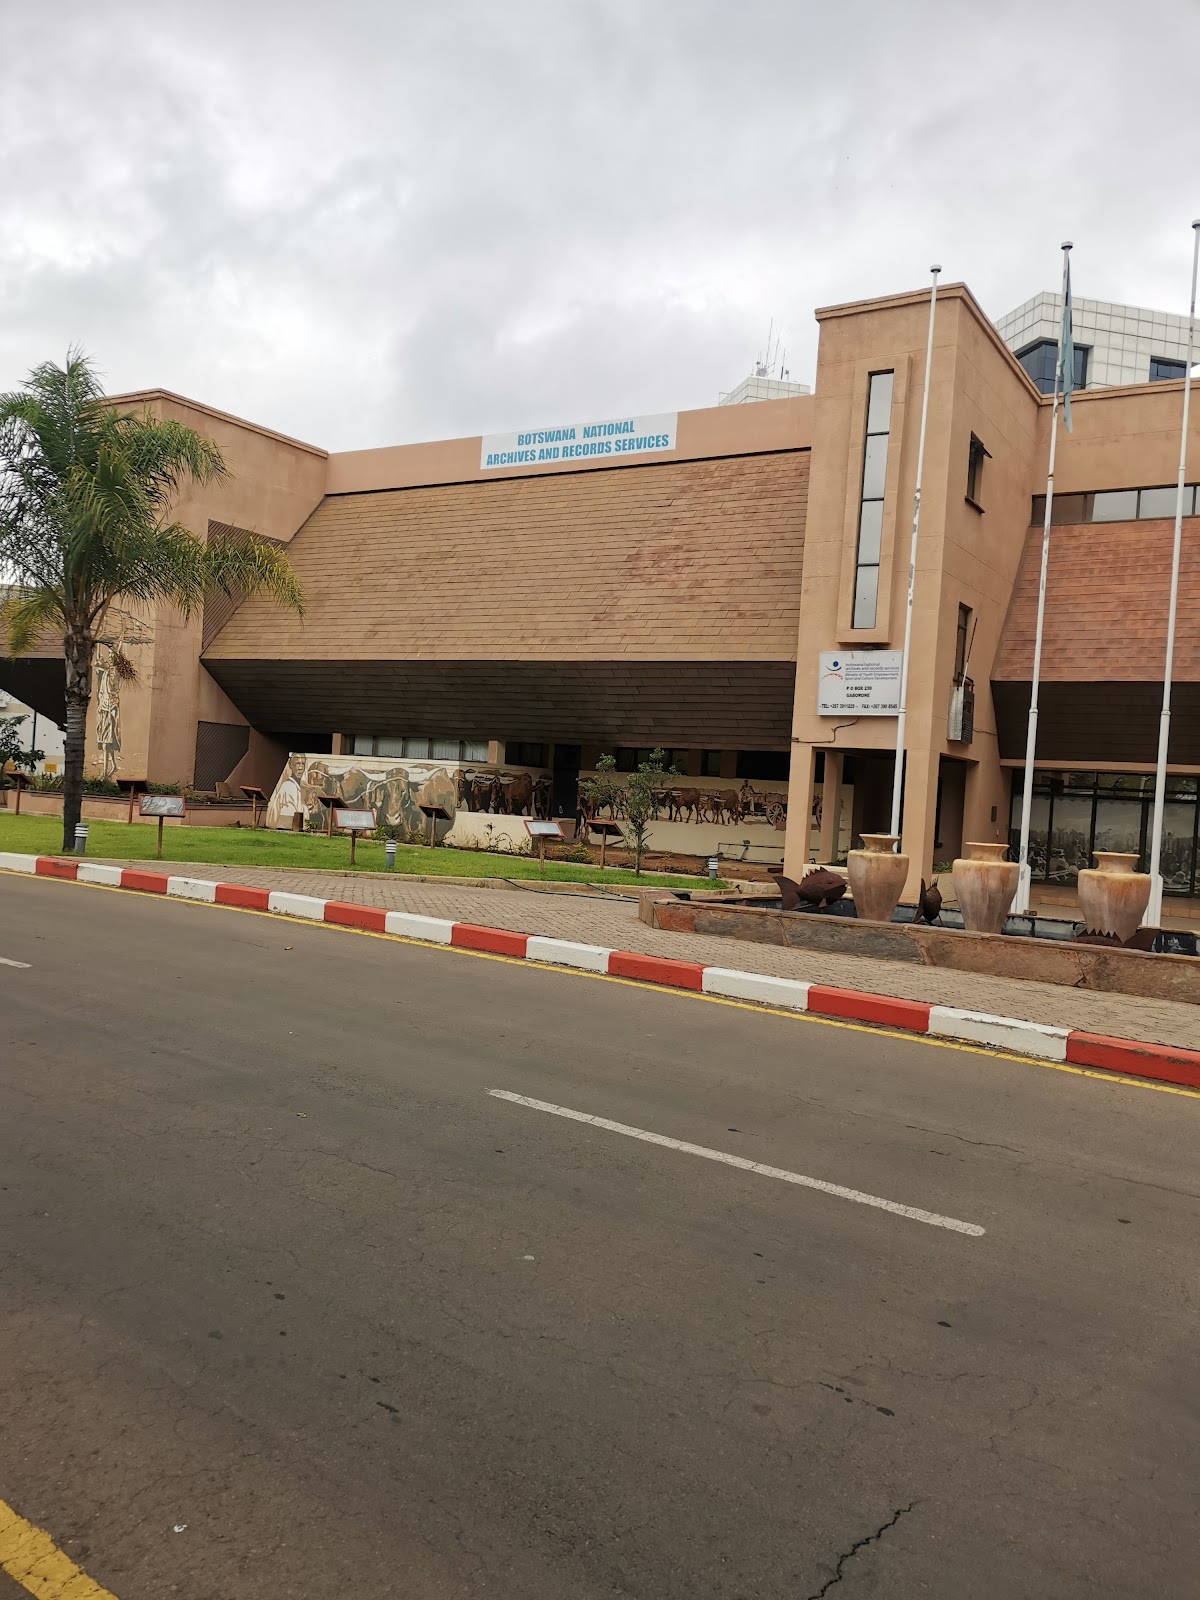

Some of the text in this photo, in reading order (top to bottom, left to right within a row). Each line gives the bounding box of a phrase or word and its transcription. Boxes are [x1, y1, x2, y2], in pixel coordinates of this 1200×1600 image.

[517, 420, 635, 446] BOTSWANA NATIONAL
[486, 434, 669, 466] ARCHIVES AND RECORDS SERVICES
